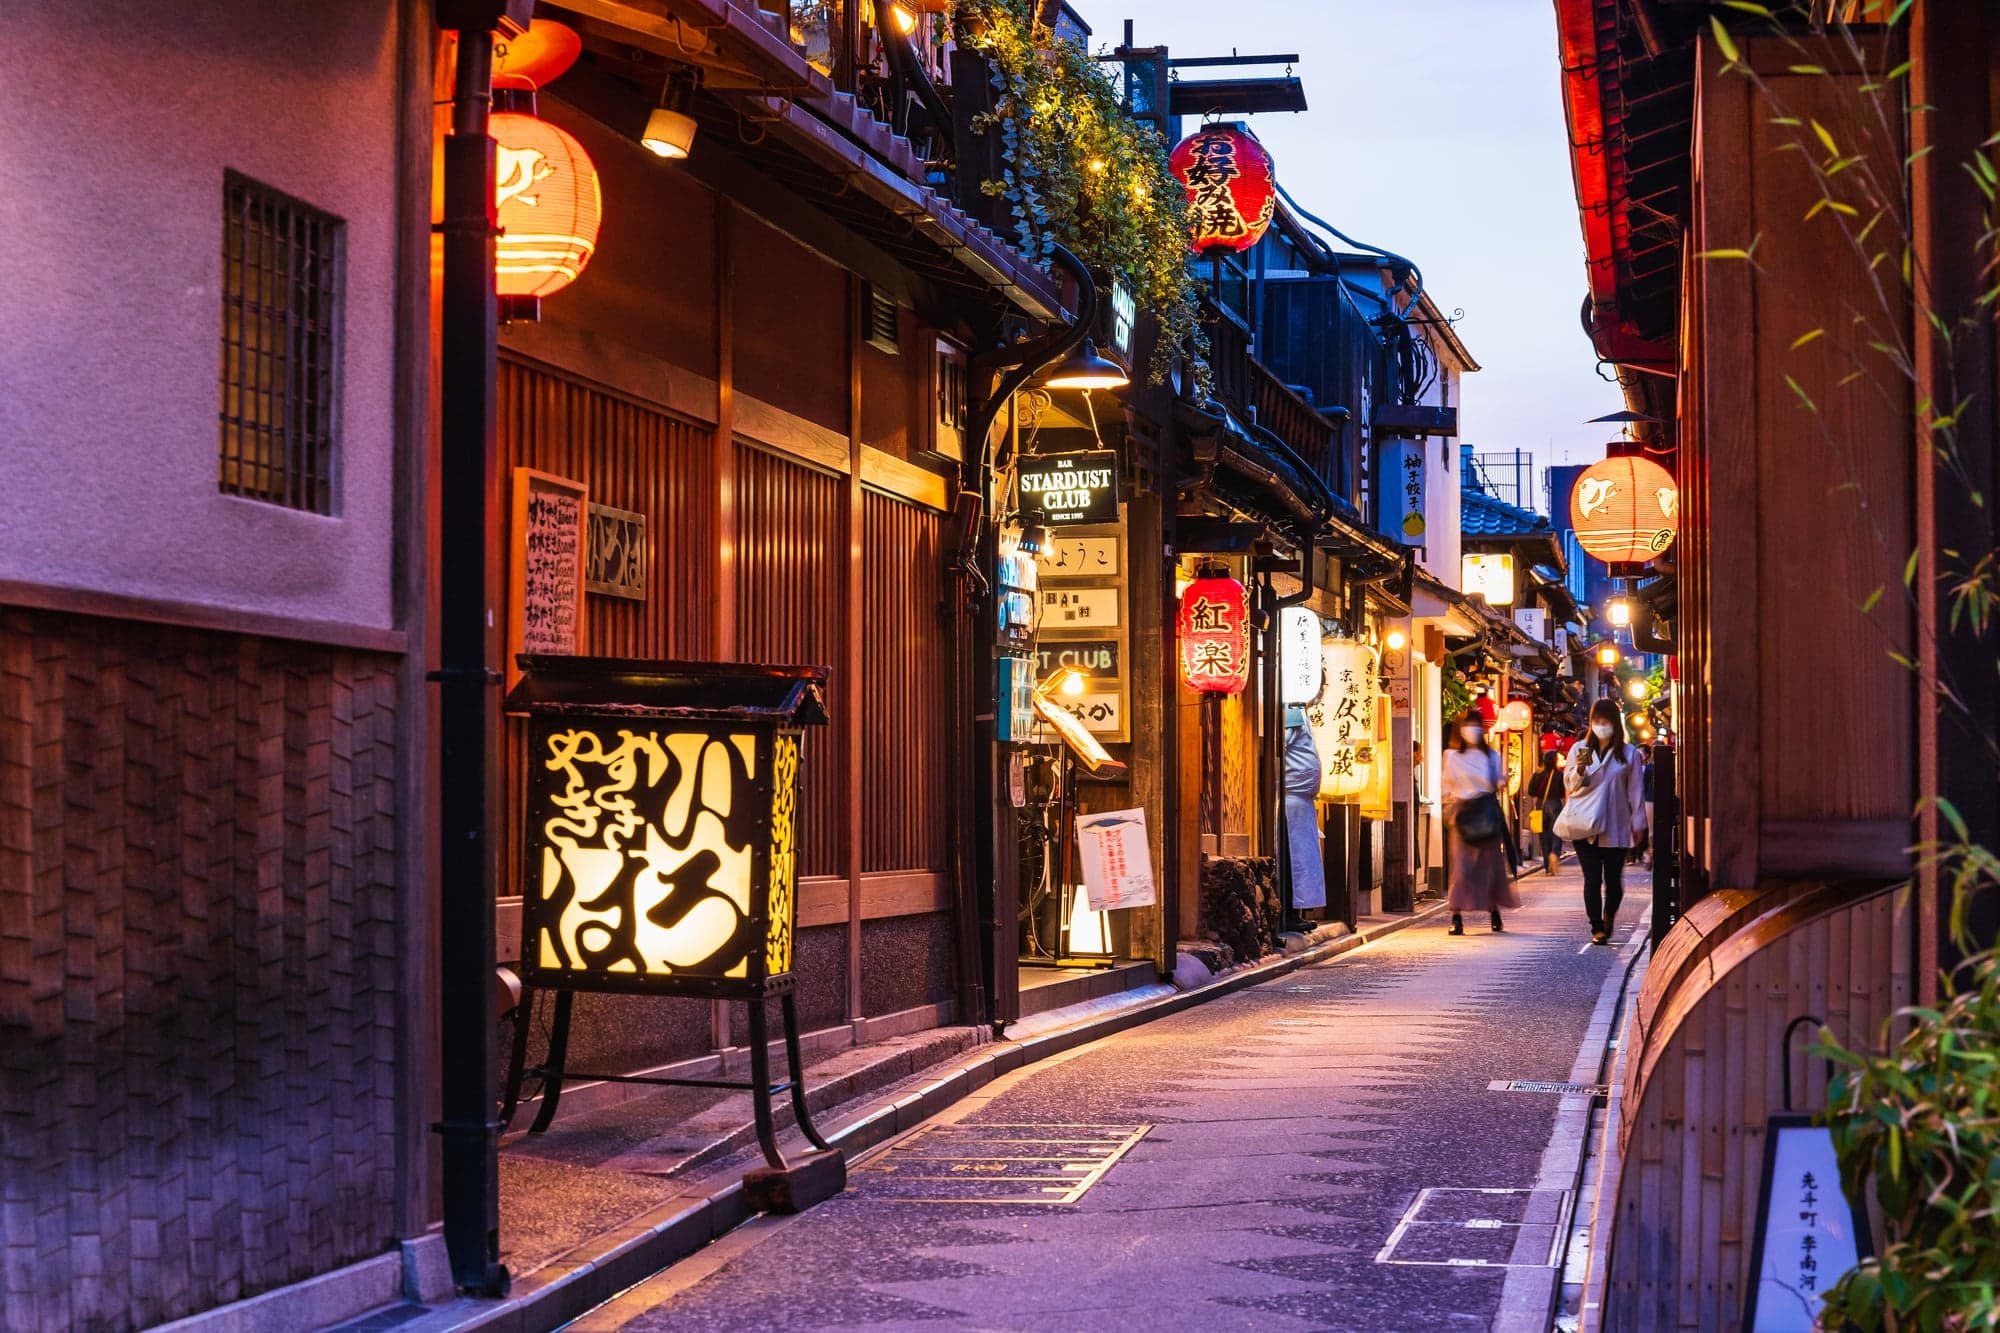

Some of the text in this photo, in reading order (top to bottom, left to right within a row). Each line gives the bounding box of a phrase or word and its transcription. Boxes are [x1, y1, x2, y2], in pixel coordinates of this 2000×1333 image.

[1057, 460, 1073, 468] BAR
[1020, 469, 1111, 492] STARDUST
[1043, 489, 1091, 509] CLUB
[1038, 542, 1109, 573] ようこ
[1191, 597, 1232, 675] 紅楽
[1059, 650, 1112, 669] CLUB
[1339, 669, 1359, 696] 京都
[1329, 697, 1360, 777] 伏見蔵
[1800, 1171, 1818, 1291] 先斗町 李南河
